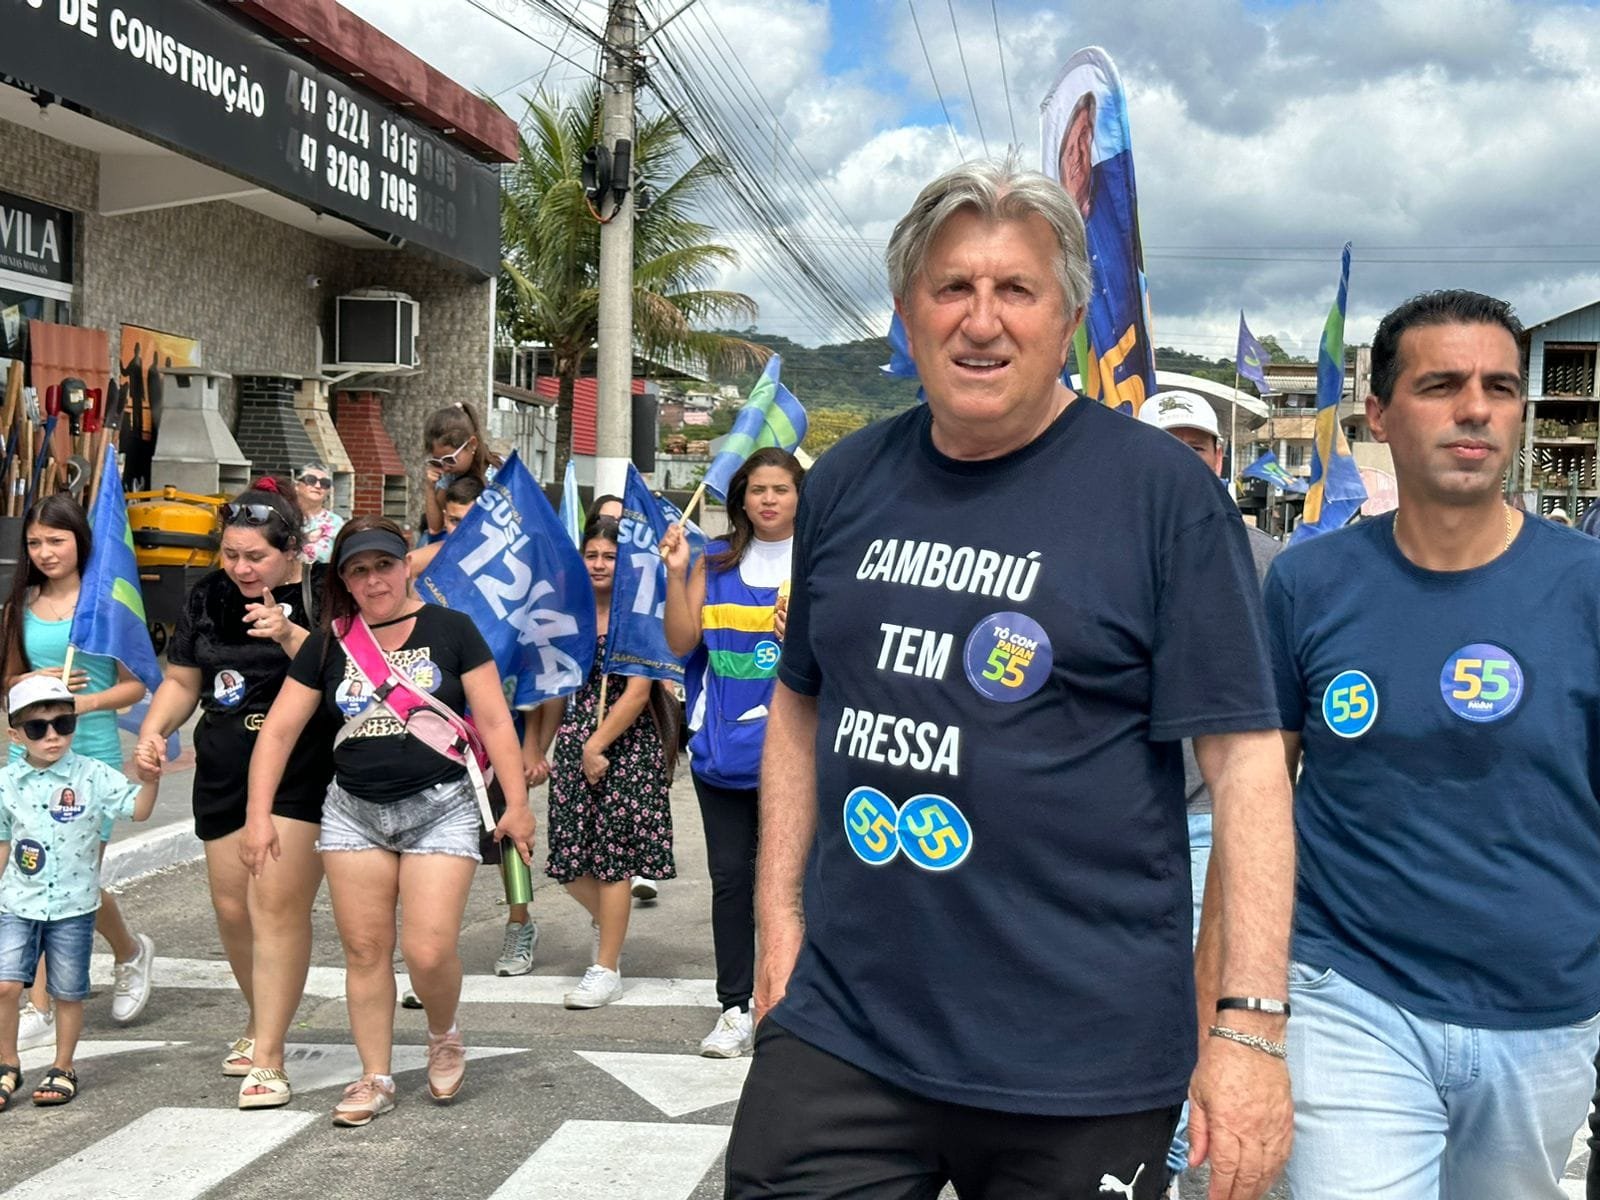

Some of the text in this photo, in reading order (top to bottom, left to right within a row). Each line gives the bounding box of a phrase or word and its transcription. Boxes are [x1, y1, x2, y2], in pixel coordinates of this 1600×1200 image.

[301, 76, 417, 176] 47 3224 1315
[301, 133, 417, 222] 47 3268 7995
[476, 489, 531, 553] SUSI
[856, 539, 1042, 602] CAMBORIÚ
[756, 646, 777, 664] 55
[876, 622, 954, 681] TEM
[993, 626, 1039, 651] TÔ COM
[996, 639, 1036, 661] PAVAN
[981, 647, 1031, 688] 55
[1452, 658, 1511, 701] 55
[1332, 683, 1369, 723] 55
[833, 706, 961, 776] PRESSA
[849, 797, 896, 853] 55
[905, 804, 963, 859] 55
[22, 853, 38, 870] 55
